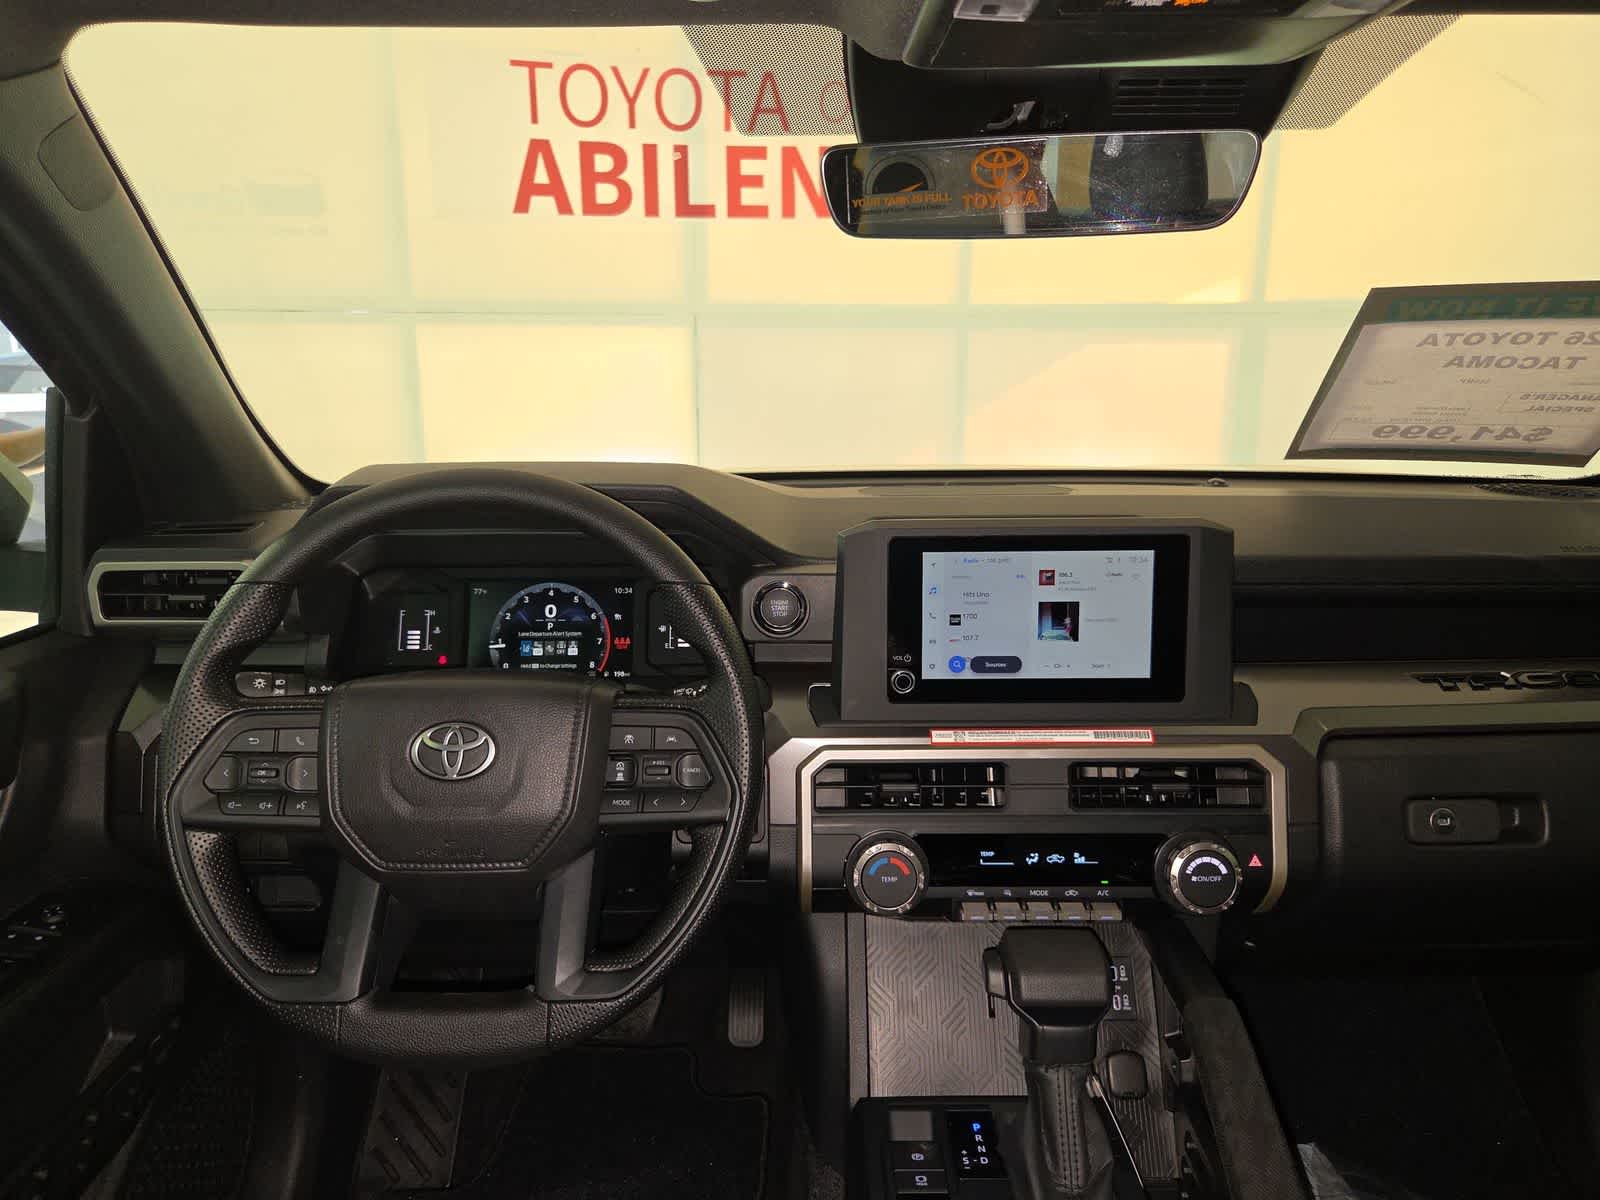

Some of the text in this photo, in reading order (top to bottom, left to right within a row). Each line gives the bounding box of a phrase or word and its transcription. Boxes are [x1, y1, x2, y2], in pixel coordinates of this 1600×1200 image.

[509, 59, 791, 134] TOYOTA
[962, 189, 1039, 209] TOYOTA
[544, 604, 557, 618] 0
[547, 622, 554, 630] P
[972, 1122, 981, 1132] P
[975, 1134, 984, 1142] R
[977, 1145, 986, 1153] N
[980, 1156, 989, 1165] D
